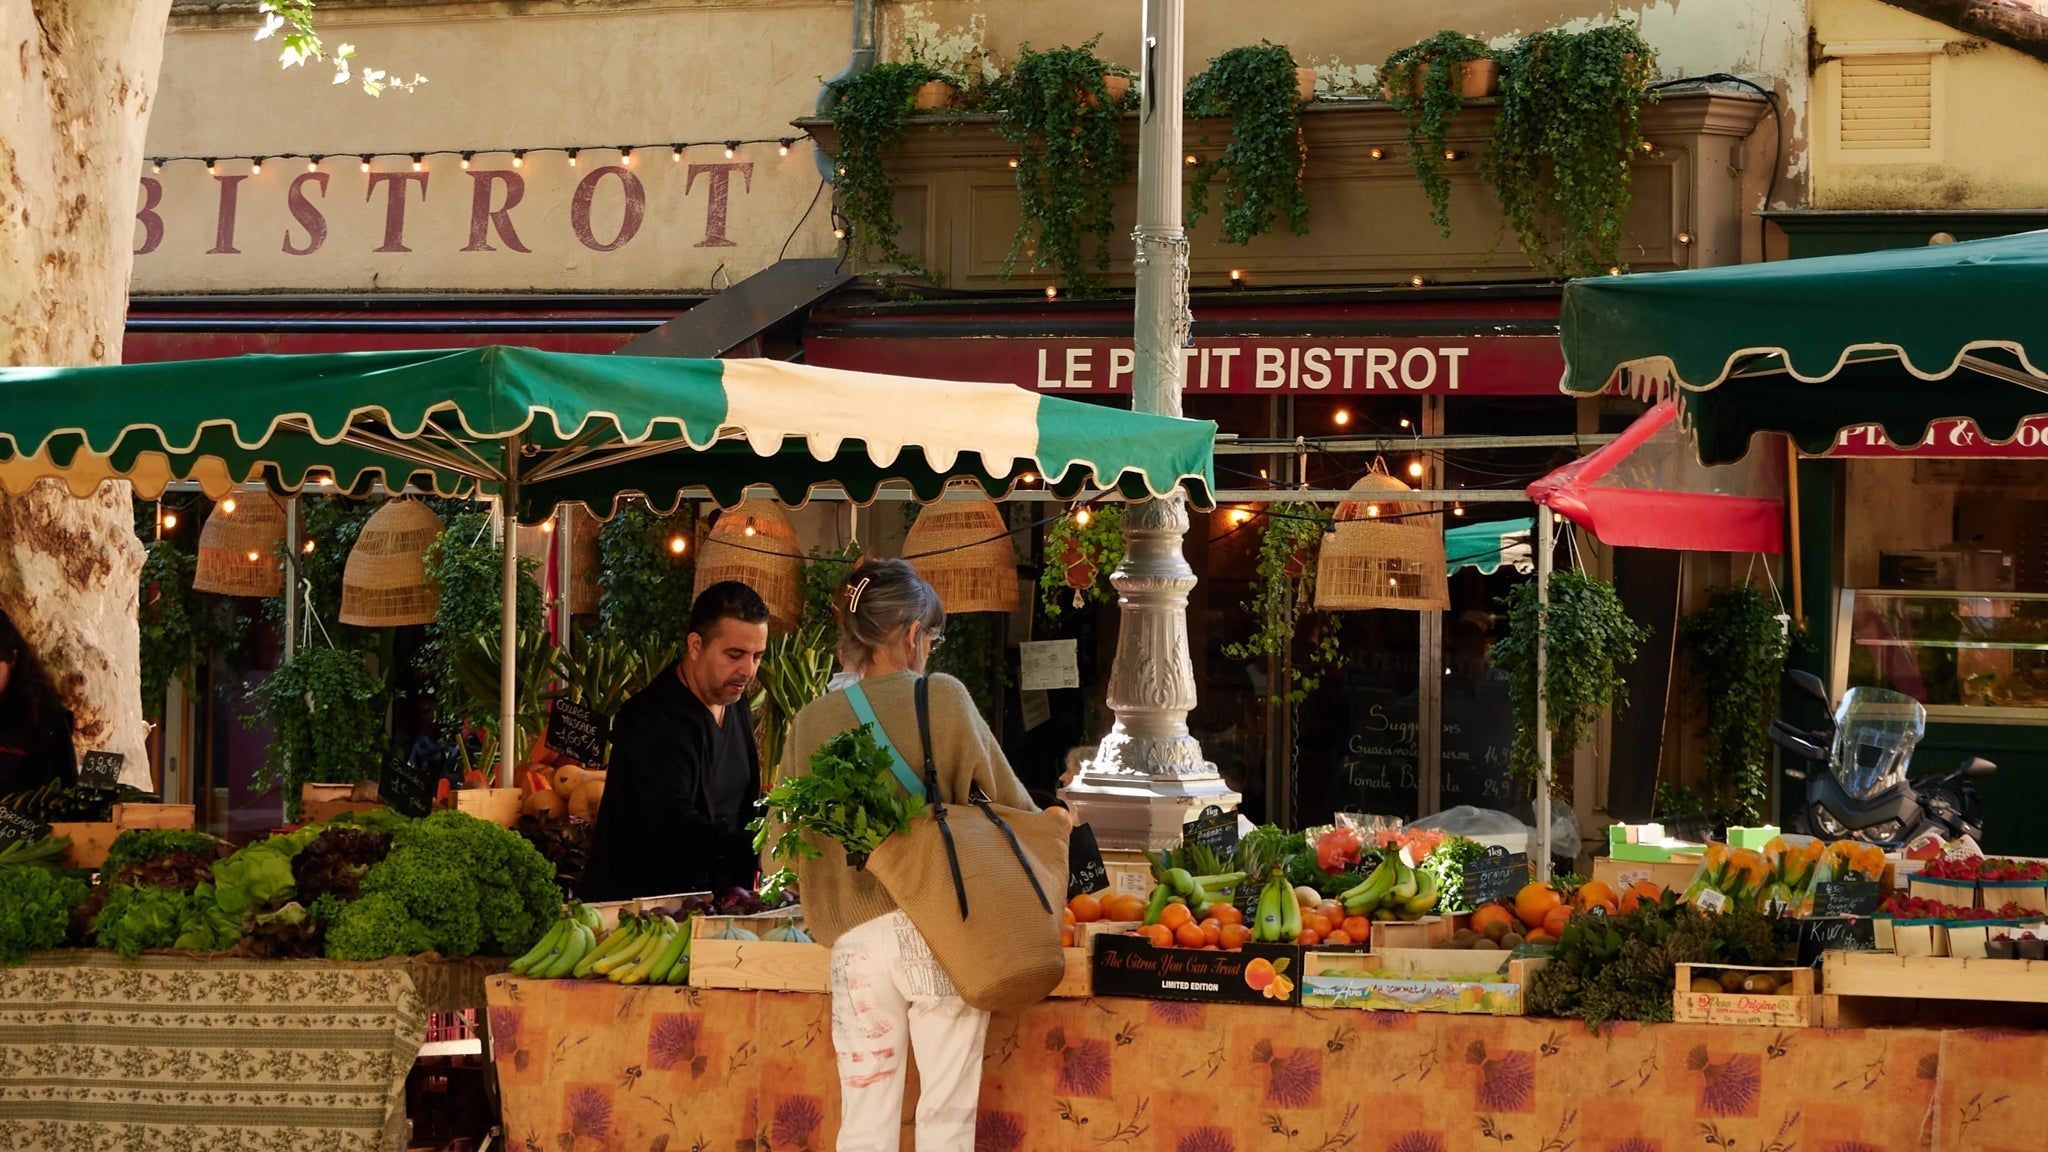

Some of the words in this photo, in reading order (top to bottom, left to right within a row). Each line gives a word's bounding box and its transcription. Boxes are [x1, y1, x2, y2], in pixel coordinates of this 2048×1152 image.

[1037, 348, 1093, 389] LE
[1109, 348, 1241, 389] PTIT
[1256, 347, 1469, 390] BISTROT
[1343, 760, 1391, 790] Tomate
[1487, 847, 1503, 857] 1kg
[1100, 950, 1122, 968] The
[1125, 952, 1157, 971] Citrus
[1158, 954, 1182, 977] You
[1185, 956, 1207, 973] Can
[1210, 957, 1242, 976] Trust
[1161, 980, 1189, 990] LIMITED
[1190, 982, 1219, 992] EDITION
[1386, 984, 1419, 994] sommet
[1421, 984, 1432, 994] du
[1737, 996, 1778, 1013] Origine
